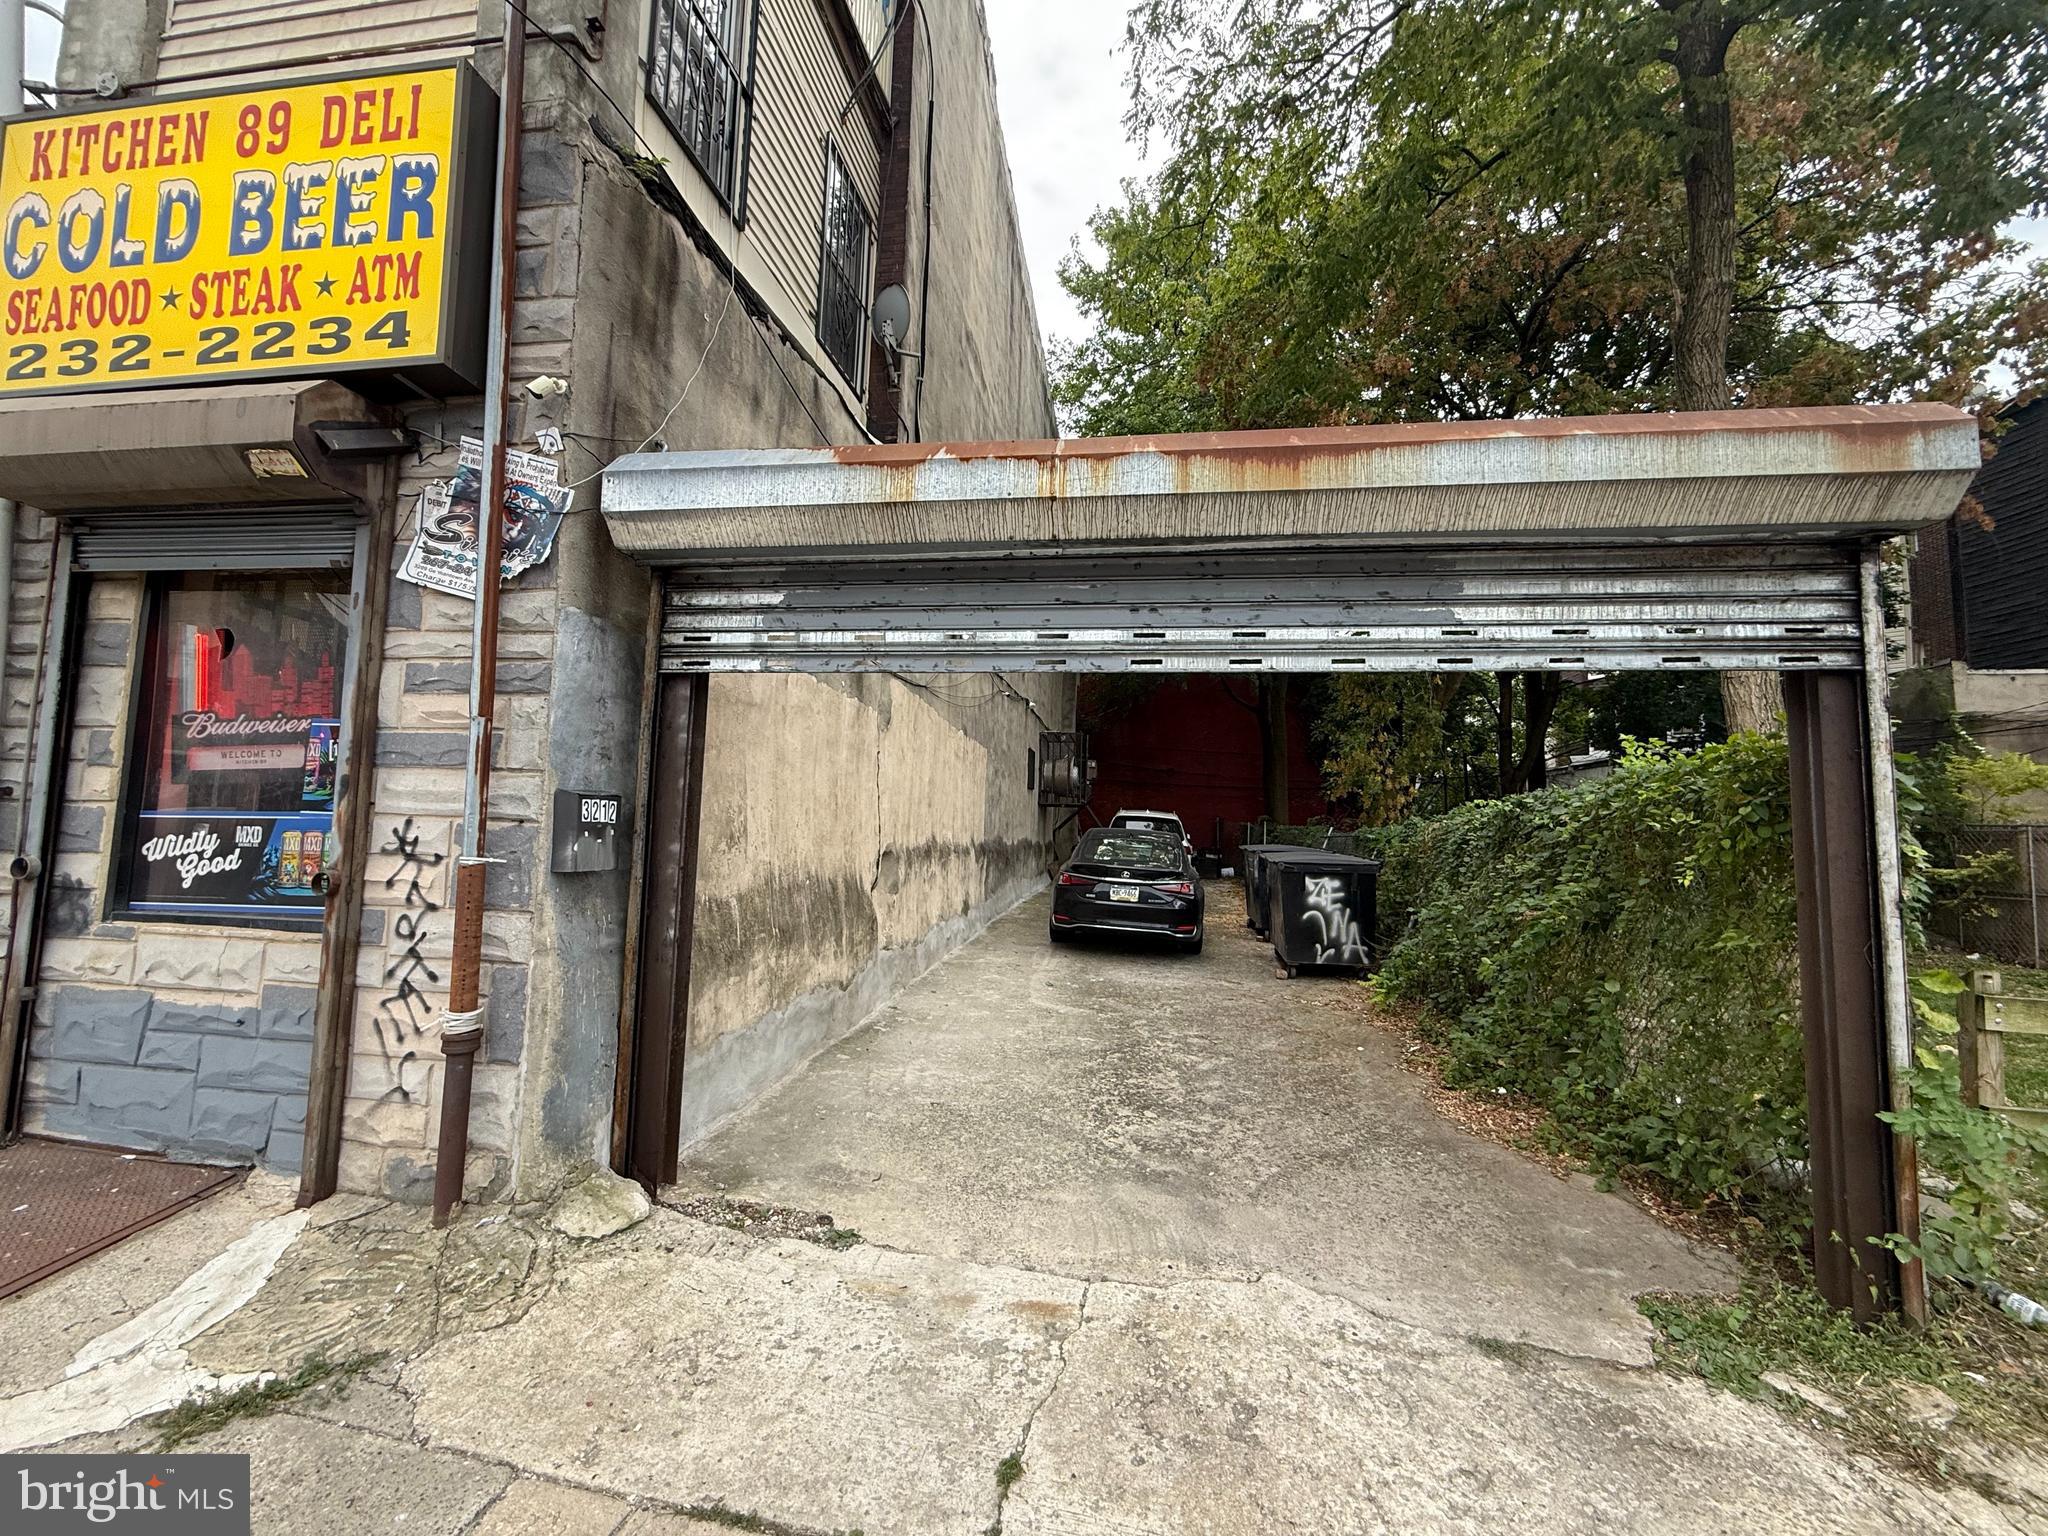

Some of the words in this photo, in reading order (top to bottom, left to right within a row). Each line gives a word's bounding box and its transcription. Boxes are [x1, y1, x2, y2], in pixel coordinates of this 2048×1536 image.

[30, 110, 210, 182] KITCHEN
[236, 101, 292, 158] 89
[320, 84, 423, 149] DELI
[3, 178, 201, 280] COLD
[229, 153, 440, 256] BEER
[5, 277, 151, 336] SEAFOOD
[189, 263, 303, 319] STEAK
[345, 250, 424, 304] ATM
[6, 311, 411, 381] 232-2234
[428, 498, 447, 508] DEBIT
[416, 571, 446, 584] Charge
[182, 713, 312, 739] Budweiser
[220, 749, 266, 759] WELCOME
[270, 749, 282, 758] TO
[583, 801, 616, 822] 3212
[141, 830, 220, 862] Wildly
[235, 825, 263, 843] MXD
[303, 837, 323, 851] MXD
[176, 848, 242, 888] Good
